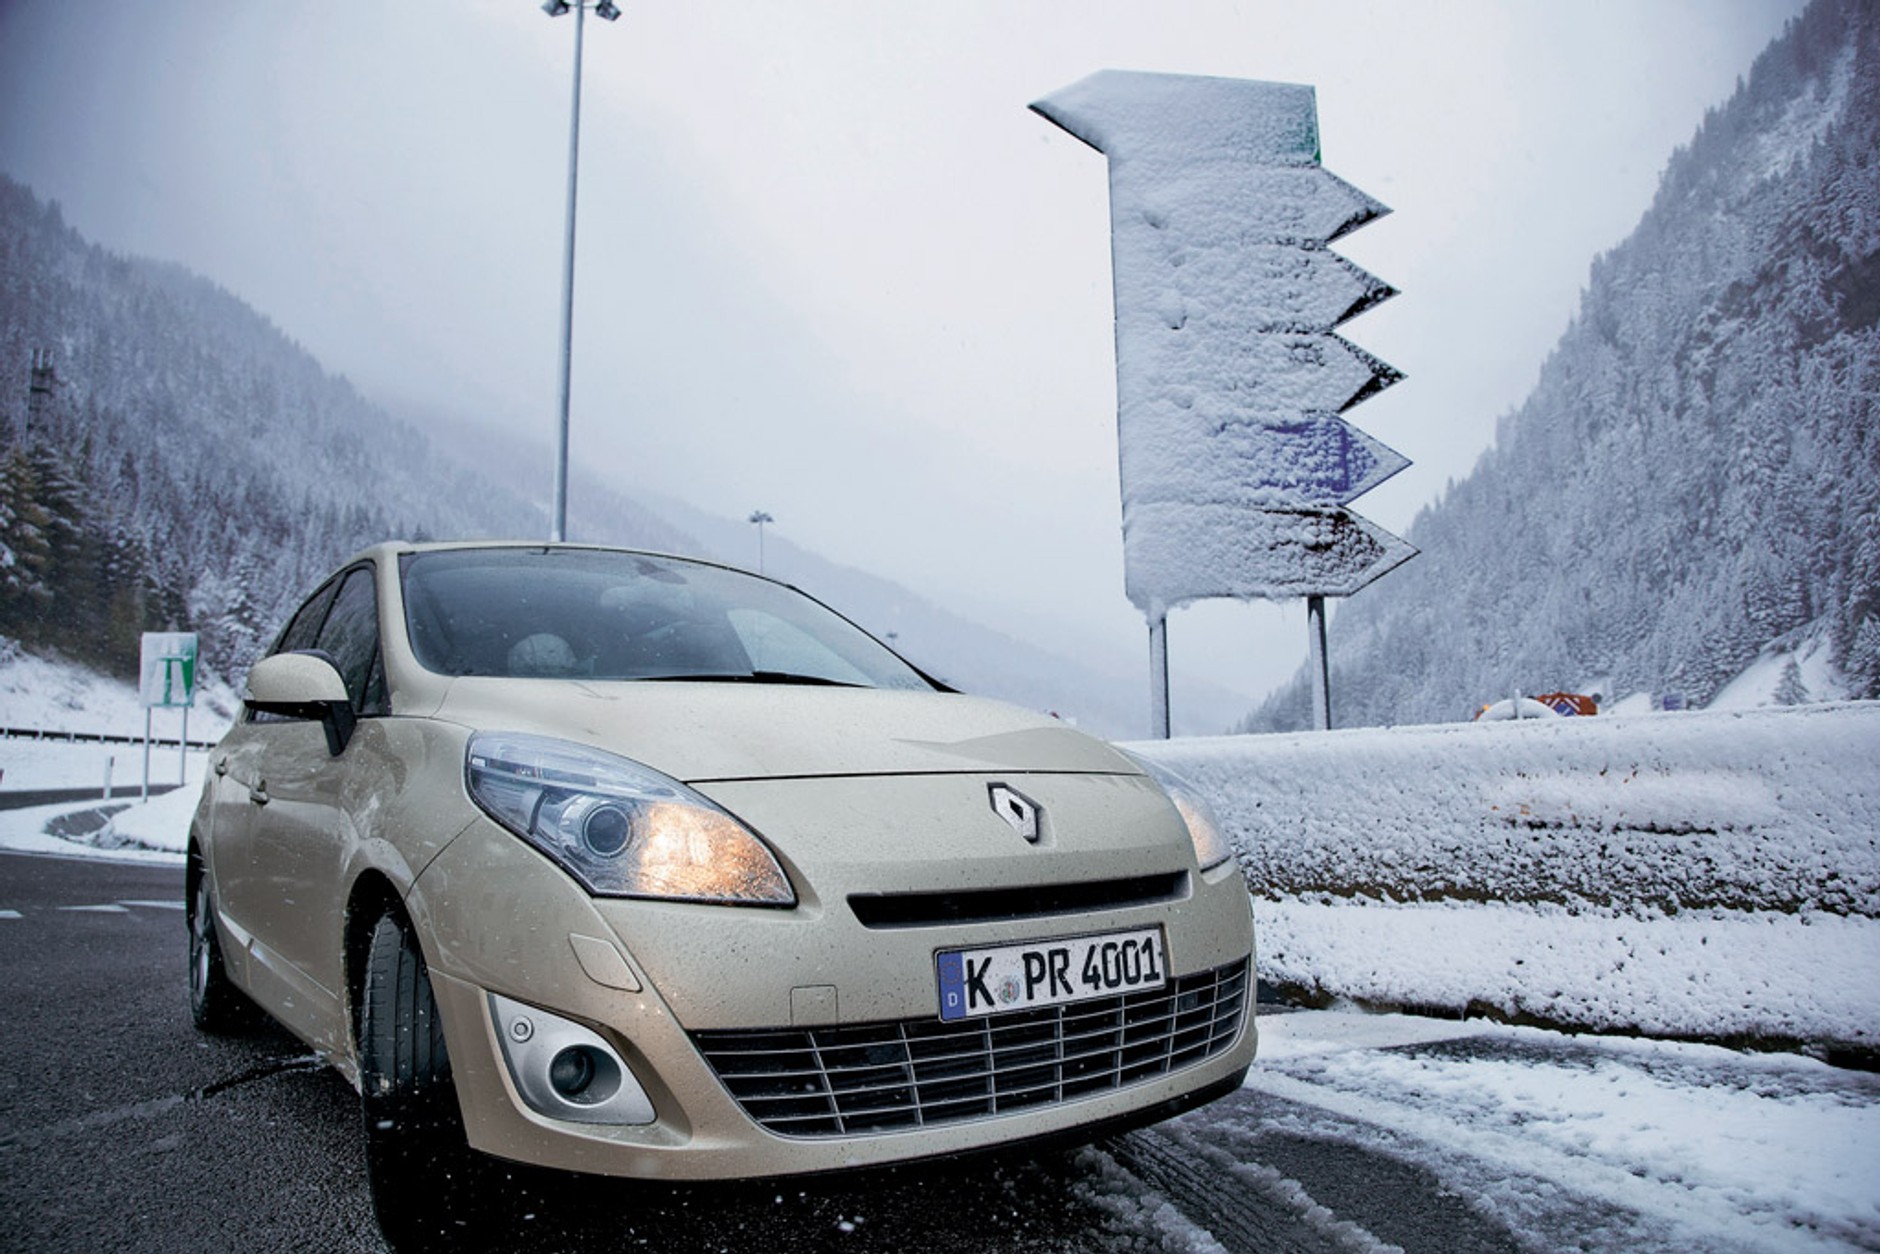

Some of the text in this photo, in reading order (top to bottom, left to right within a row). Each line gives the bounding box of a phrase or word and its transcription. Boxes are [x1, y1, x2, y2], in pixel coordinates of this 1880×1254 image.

[948, 936, 1161, 1009] D K PR 4001
